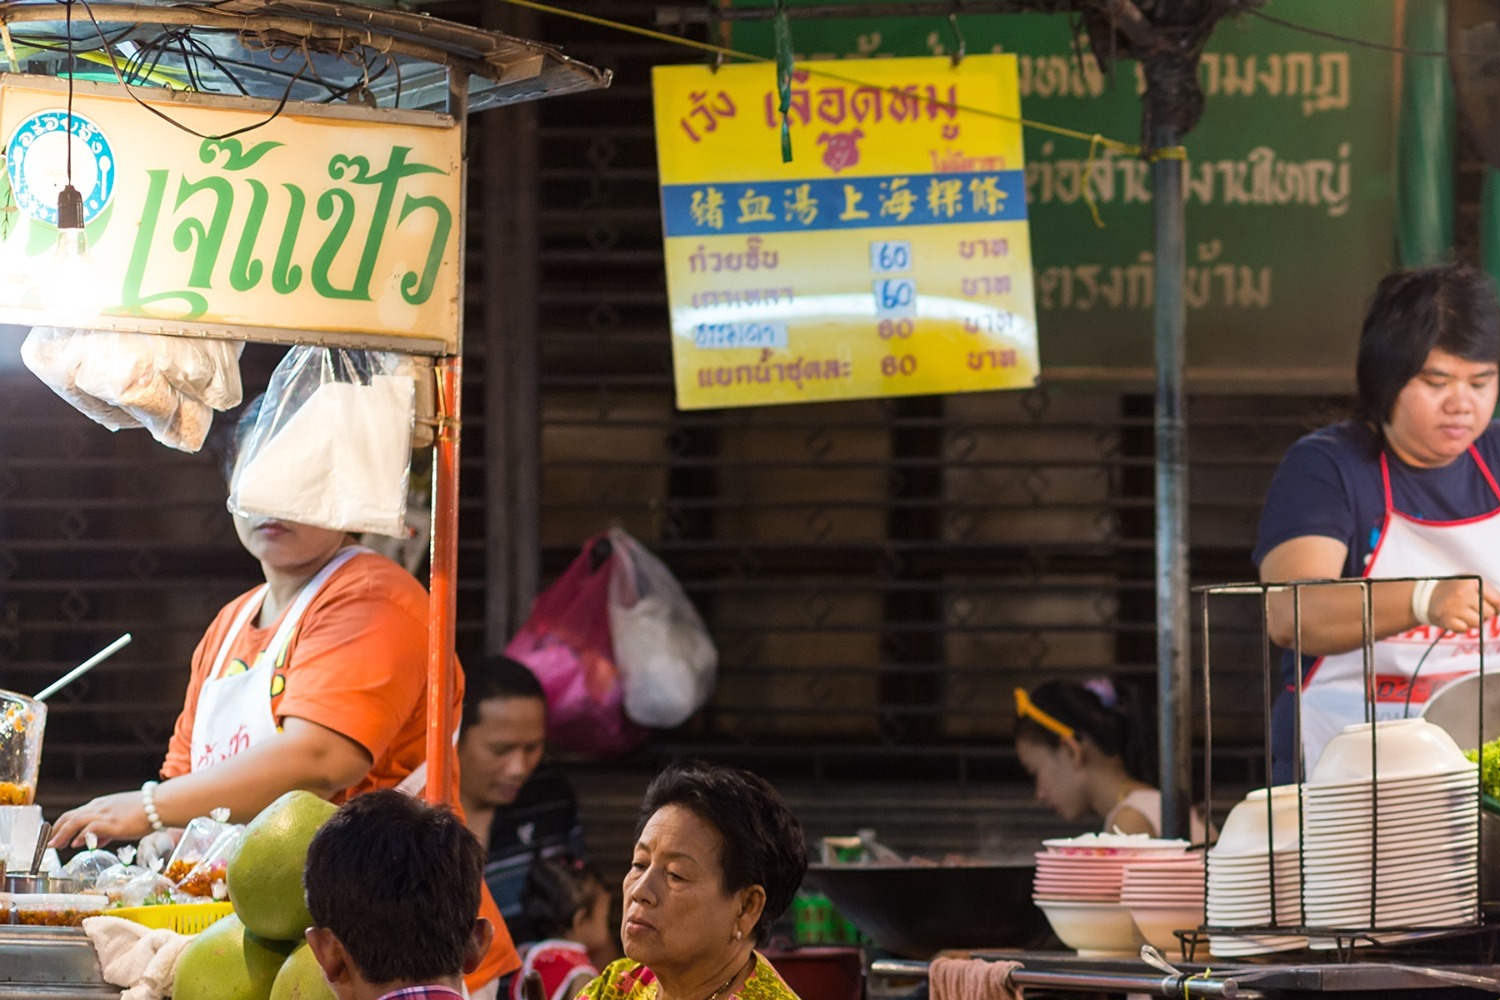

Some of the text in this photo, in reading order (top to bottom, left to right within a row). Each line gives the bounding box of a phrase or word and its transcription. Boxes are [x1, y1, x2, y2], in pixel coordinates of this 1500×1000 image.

[121, 136, 452, 318] เจ๊แป๊ว
[879, 243, 908, 270] 60
[959, 238, 1009, 259] บาท
[882, 279, 913, 309] 60
[961, 275, 1012, 297] บาท
[877, 318, 915, 341] 60
[963, 311, 1014, 333] บาท
[881, 354, 918, 377] 60
[967, 349, 1018, 371] บาท
